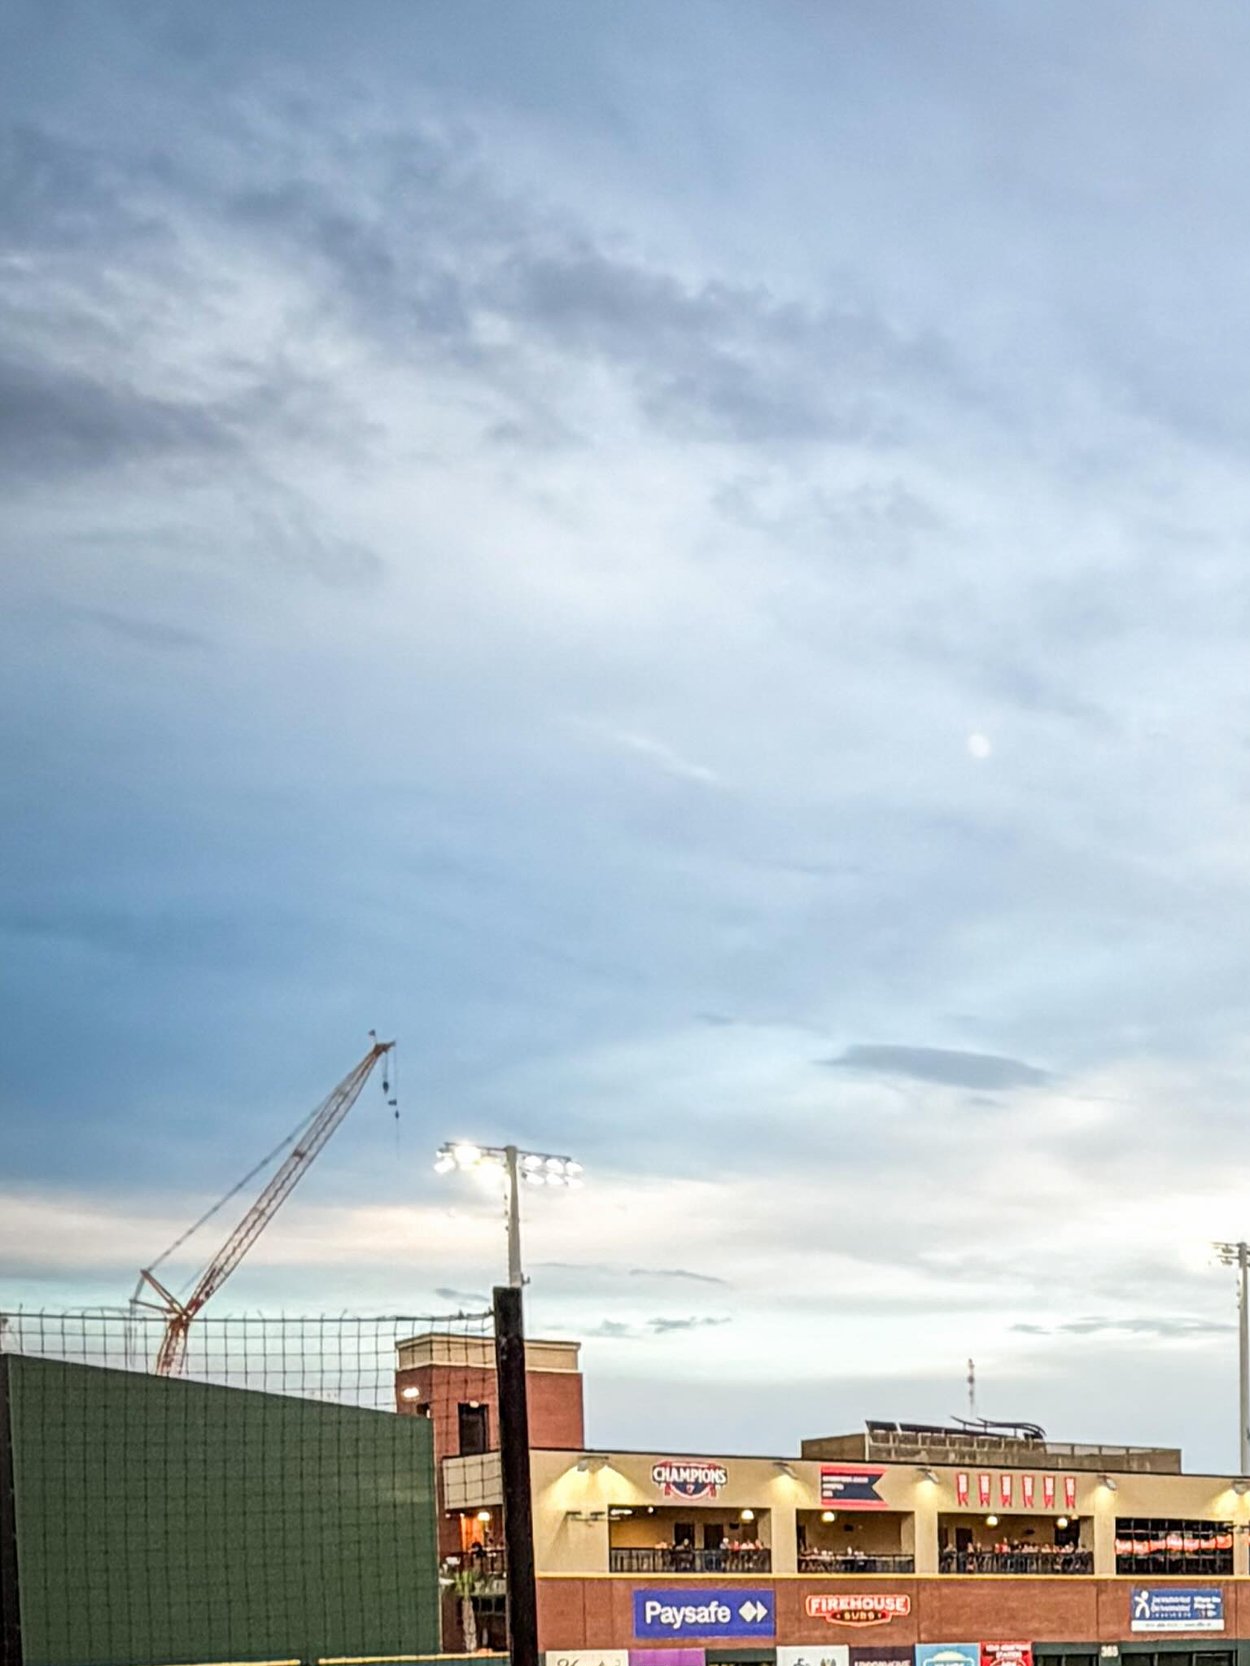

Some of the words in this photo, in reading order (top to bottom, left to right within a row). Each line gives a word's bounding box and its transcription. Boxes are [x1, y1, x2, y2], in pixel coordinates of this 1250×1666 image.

[653, 1467, 727, 1484] CHAMPIONS
[810, 1598, 907, 1613] FIREHOUSE
[645, 1600, 731, 1629] Paysafe
